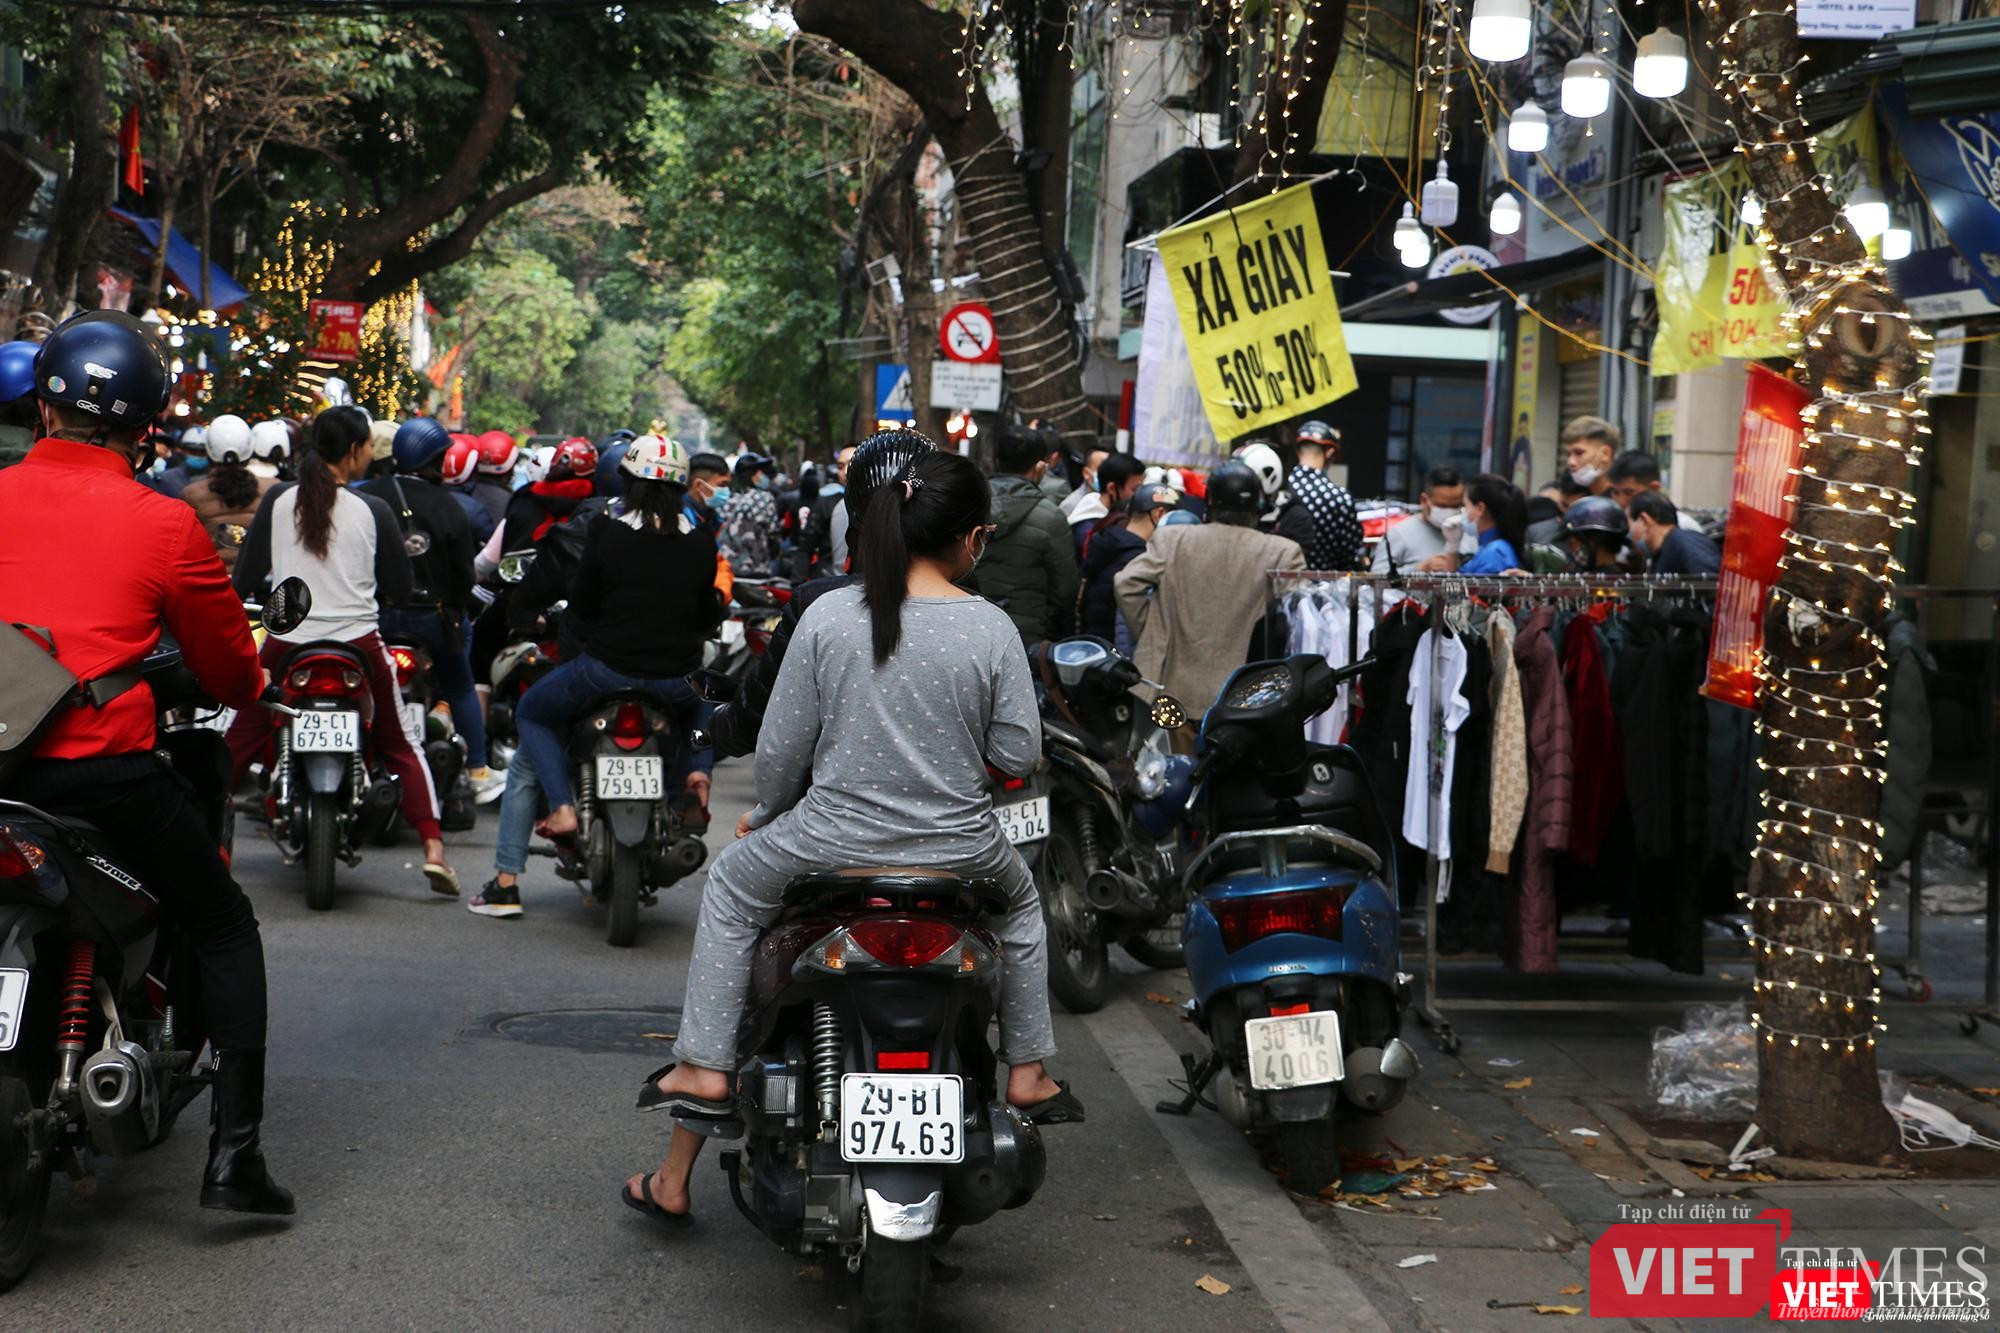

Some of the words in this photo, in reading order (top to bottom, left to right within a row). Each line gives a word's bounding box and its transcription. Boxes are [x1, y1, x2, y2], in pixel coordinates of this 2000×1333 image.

[1182, 231, 1238, 335] XẢ
[303, 713, 347, 729] 29-C1
[607, 759, 652, 776] 29-E1
[601, 778, 660, 796] 759.13
[1259, 1018, 1326, 1052] 30-H4
[1263, 1049, 1330, 1083] 4006
[861, 1081, 942, 1117] 29-B1
[850, 1121, 955, 1156] 974.63
